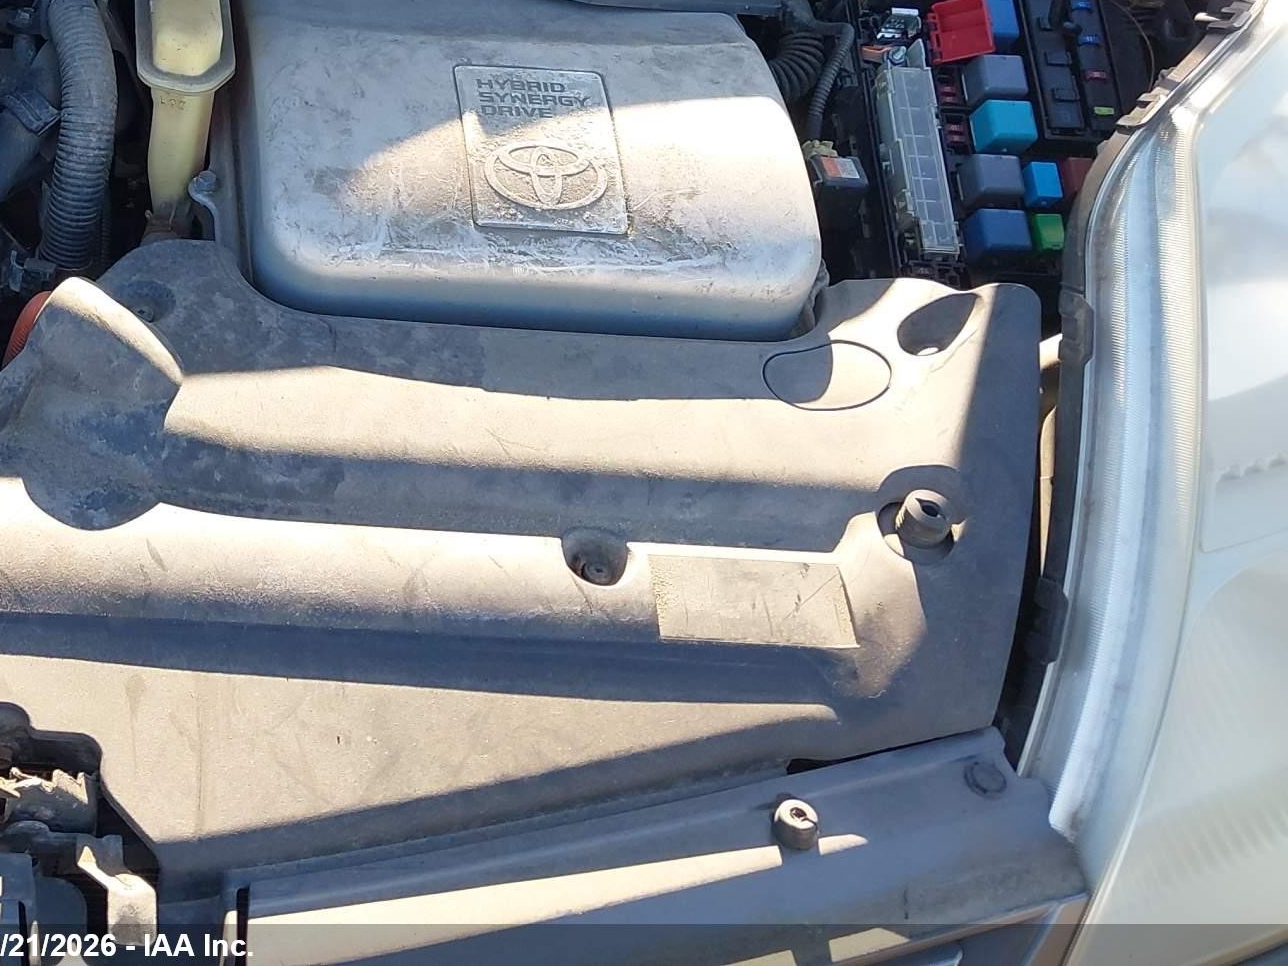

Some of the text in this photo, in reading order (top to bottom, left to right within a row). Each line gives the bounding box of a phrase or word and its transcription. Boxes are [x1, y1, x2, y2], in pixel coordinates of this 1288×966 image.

[476, 78, 567, 92] HYBRID
[479, 92, 591, 107] SYNERGY
[480, 106, 554, 119] DRIVE
